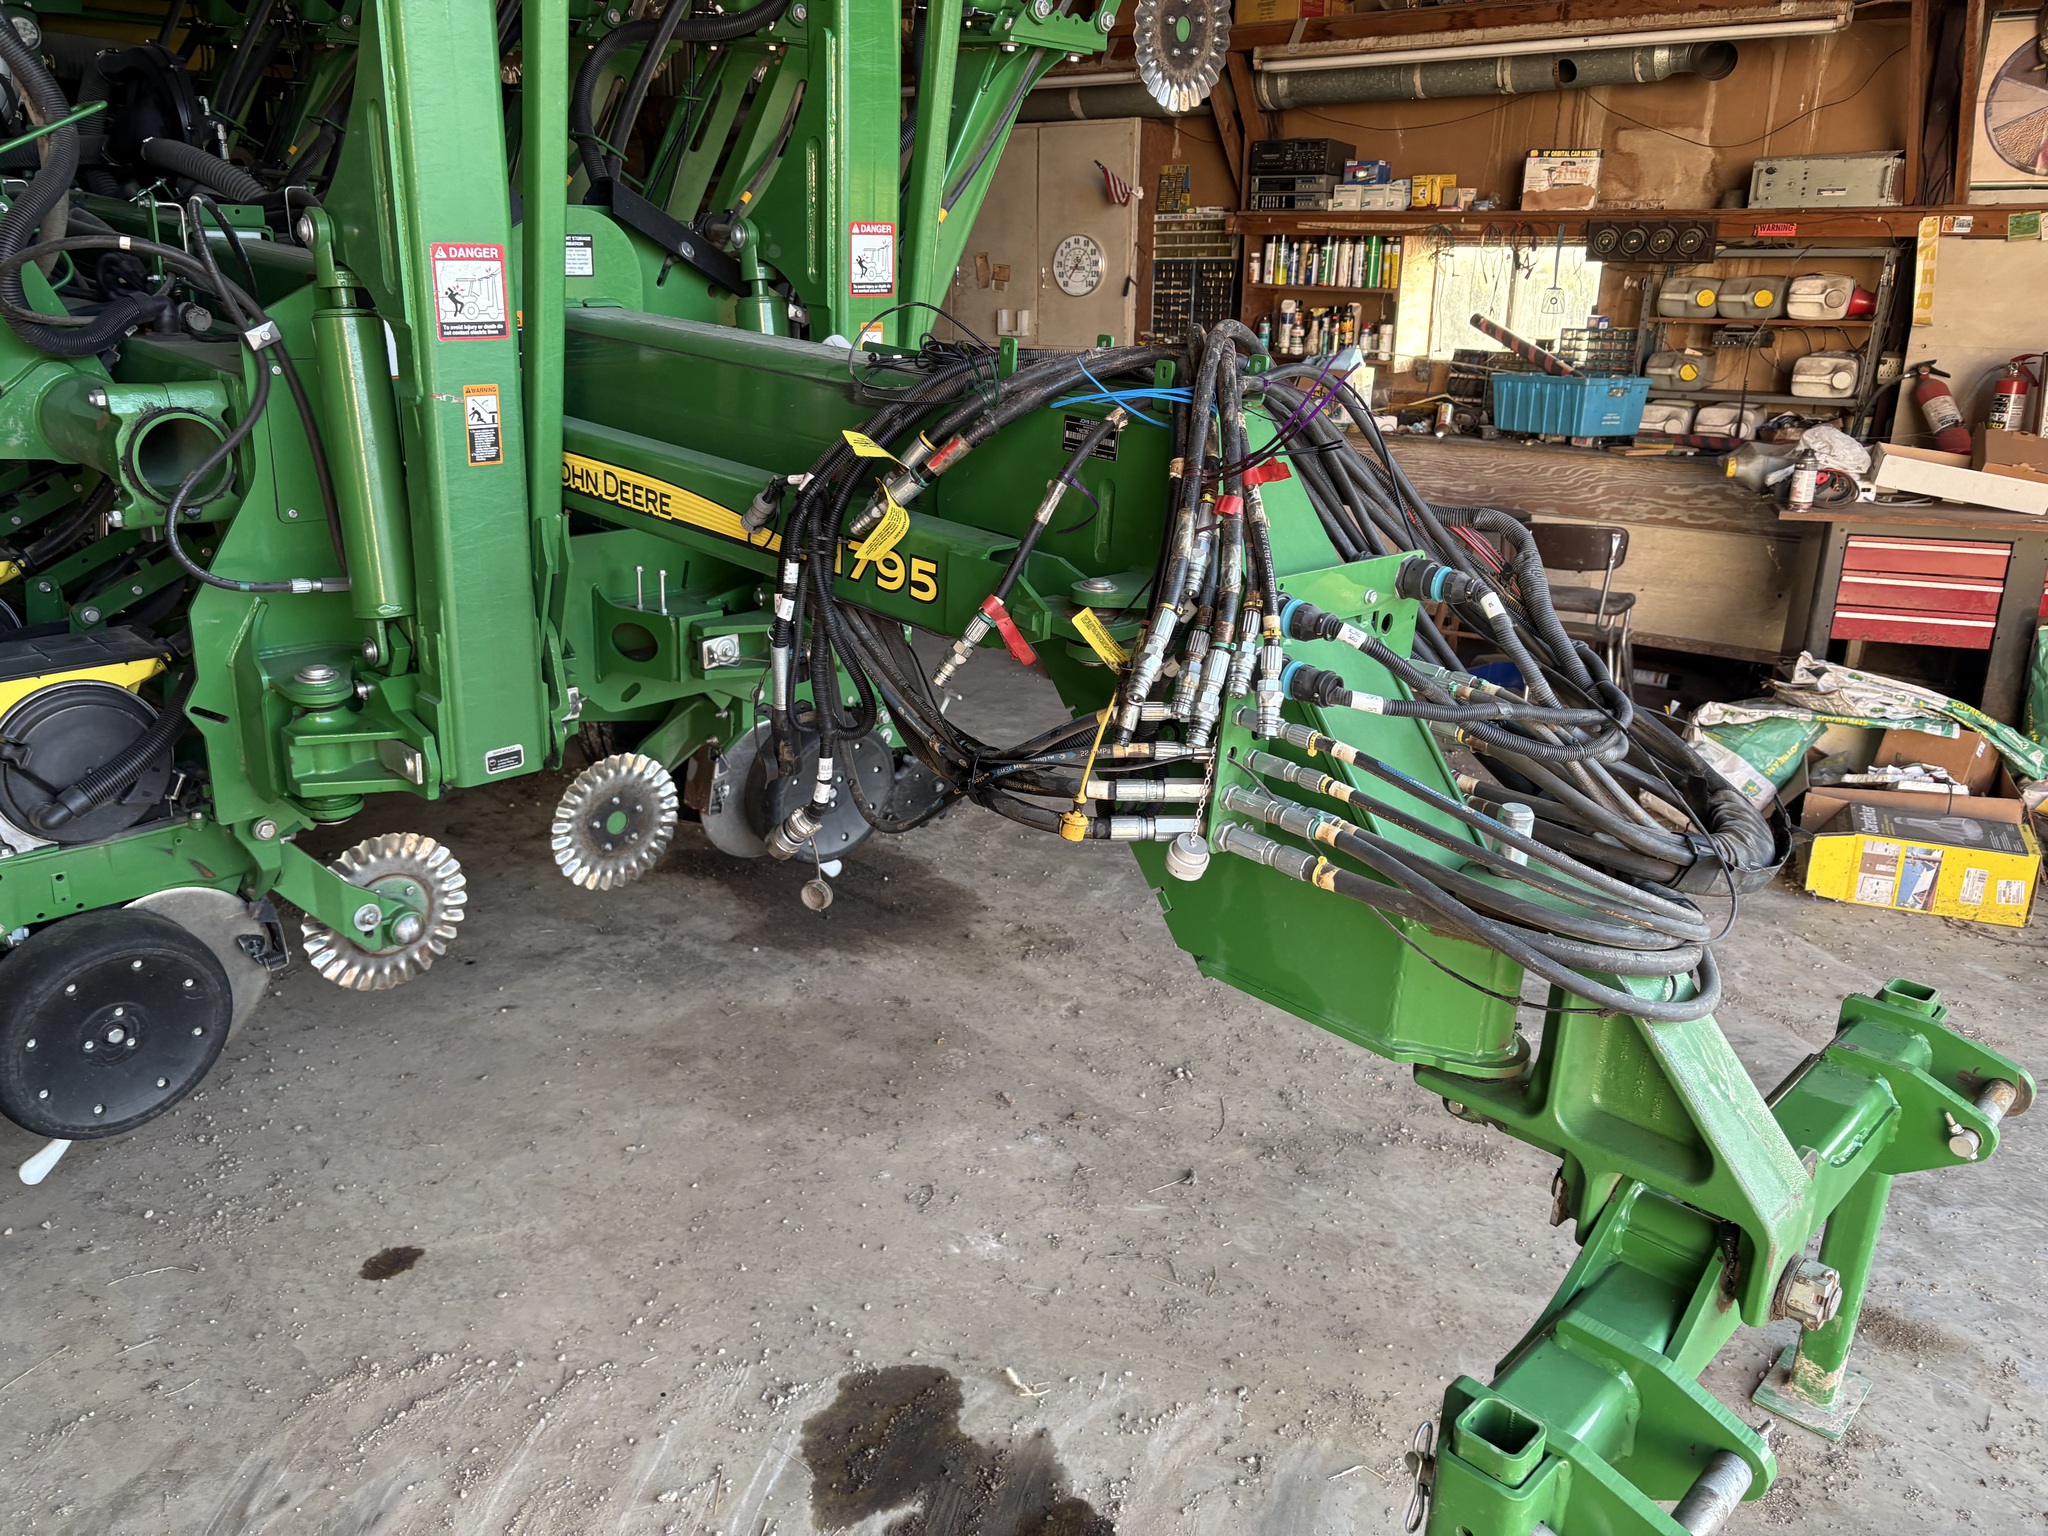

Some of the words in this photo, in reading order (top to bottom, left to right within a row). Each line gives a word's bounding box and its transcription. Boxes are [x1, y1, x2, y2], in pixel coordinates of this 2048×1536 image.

[860, 224, 892, 233] DANGER
[448, 247, 498, 259] DANGER
[562, 461, 598, 493] OHN
[603, 469, 672, 517] DEERE
[833, 537, 938, 602] 1795
[1266, 560, 1276, 592] ISO11237
[1816, 715, 1869, 726] SOYBEANS
[1951, 701, 1998, 727] SOYBEANS
[1765, 741, 1800, 776] SOYBEANS
